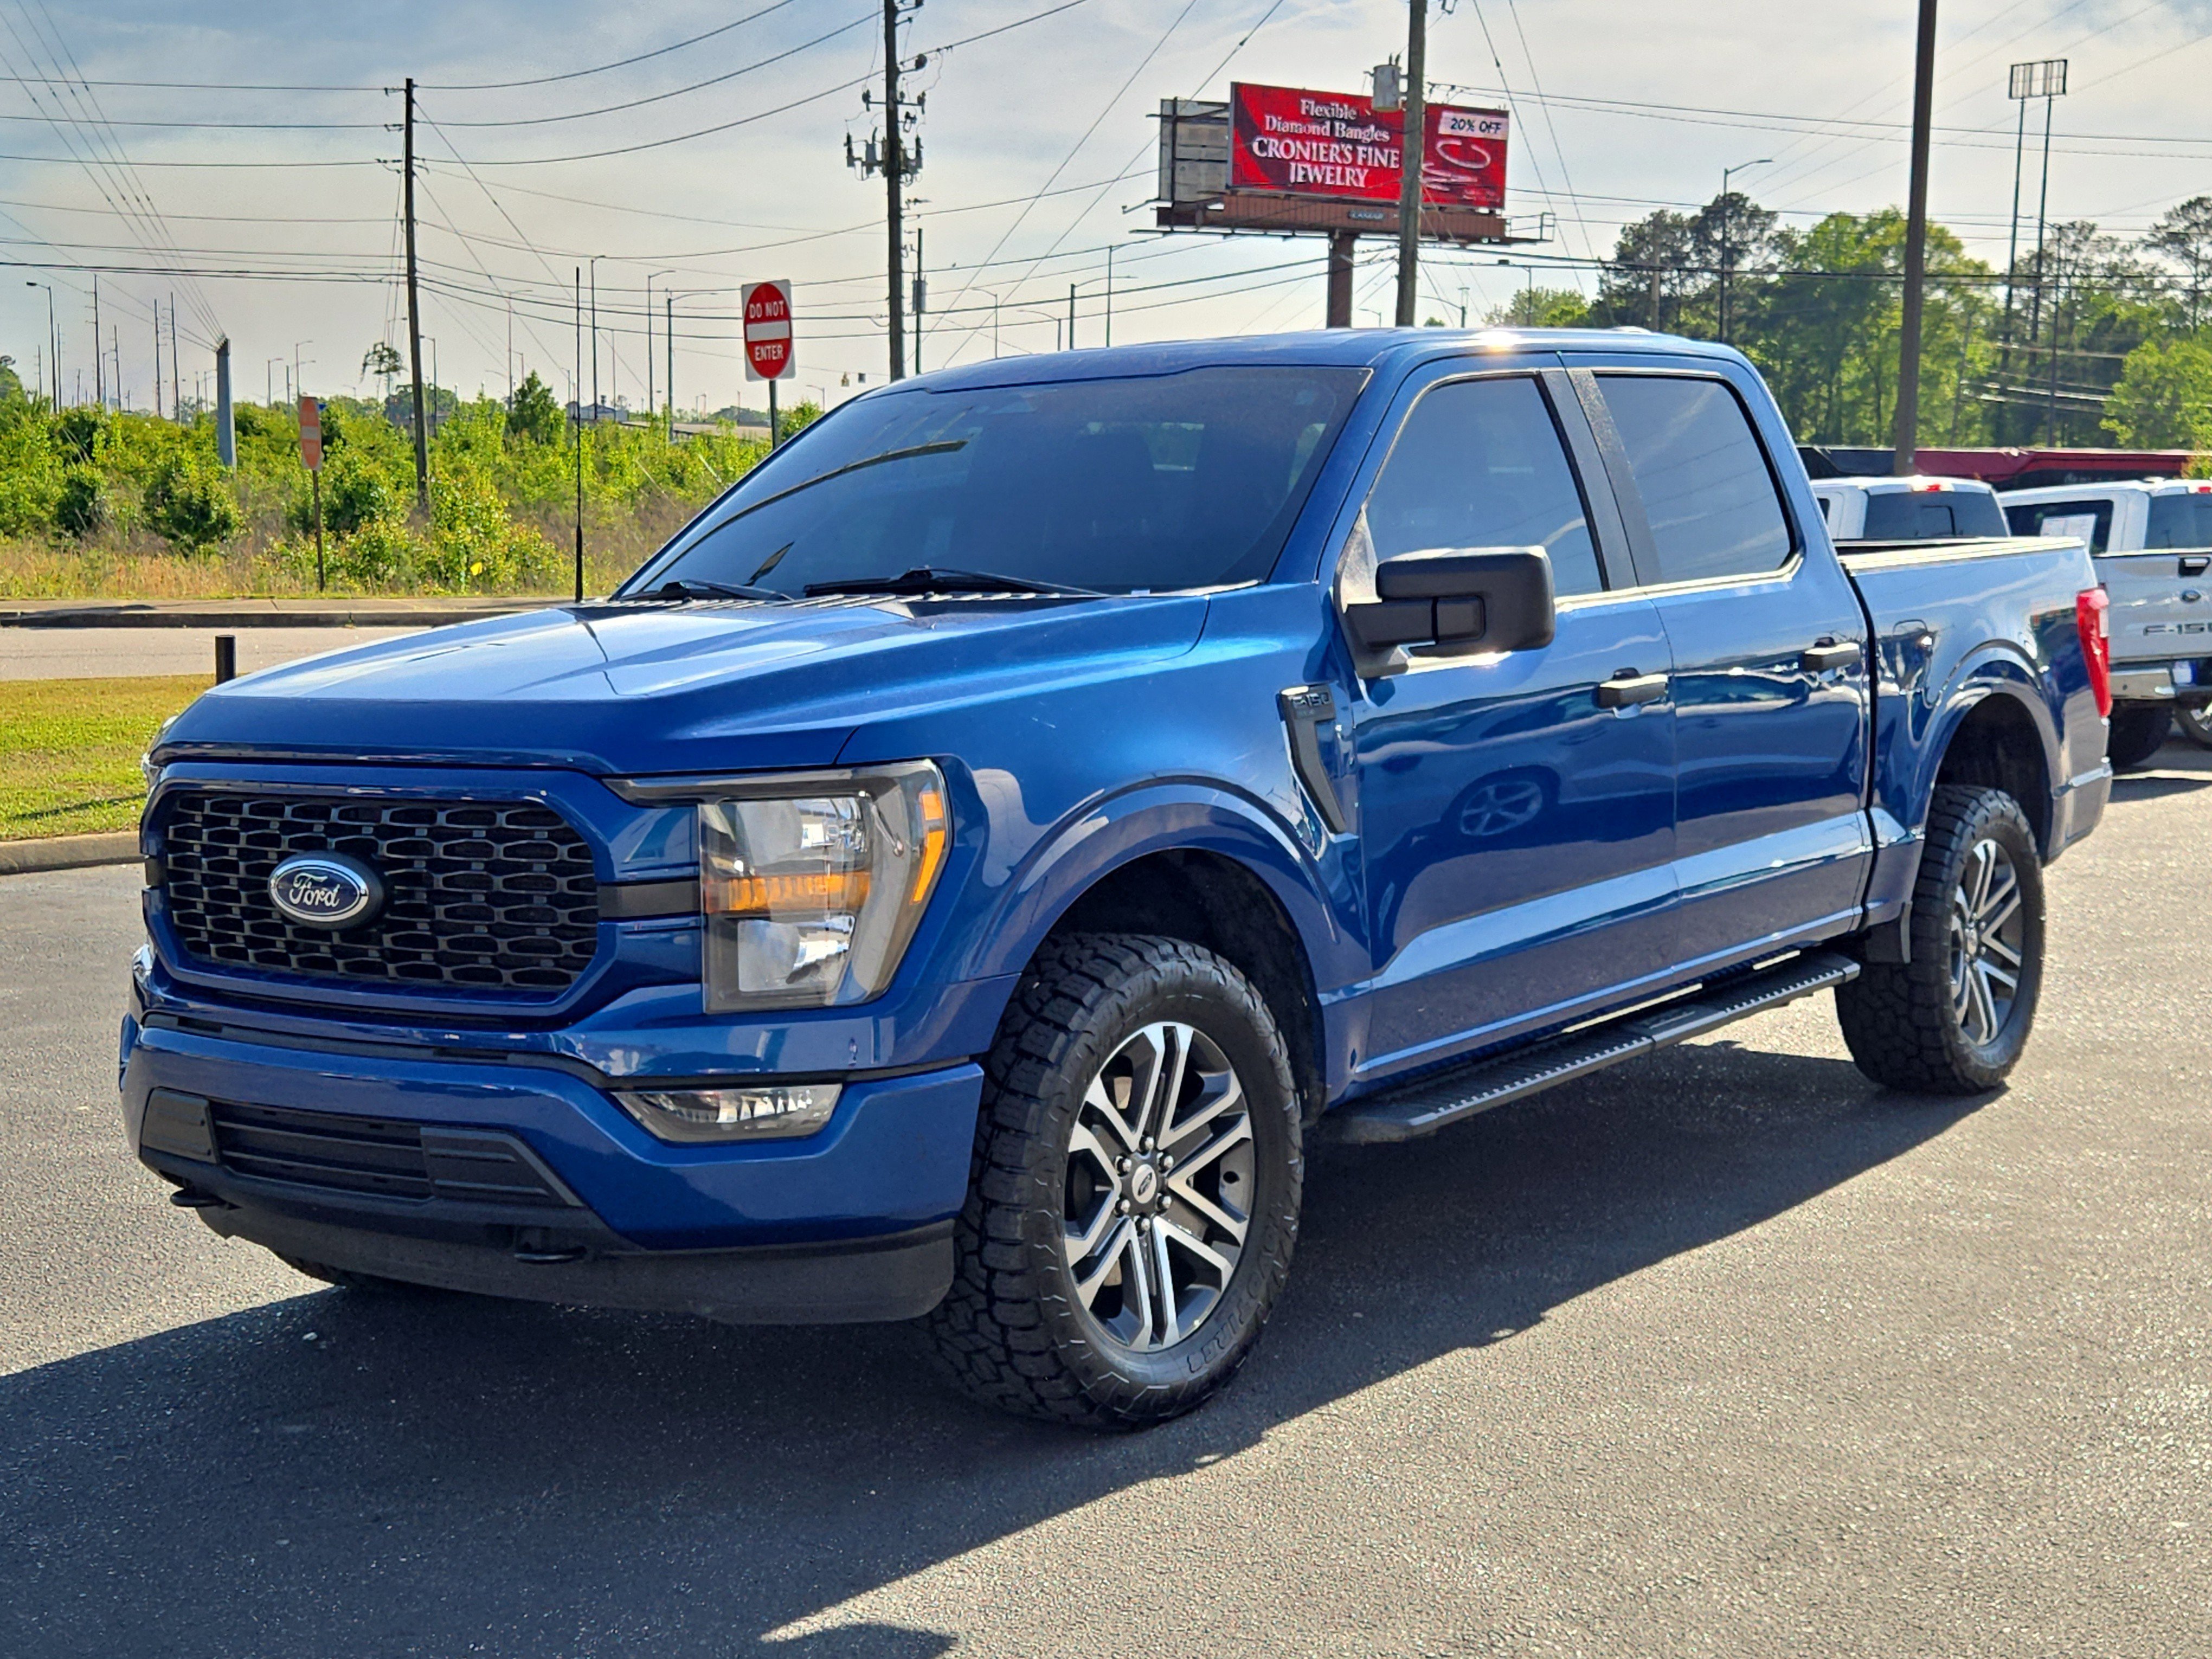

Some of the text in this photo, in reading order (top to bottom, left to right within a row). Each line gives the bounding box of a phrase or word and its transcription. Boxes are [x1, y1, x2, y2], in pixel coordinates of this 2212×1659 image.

[1301, 99, 1356, 120] Flexible
[1264, 114, 1390, 143] Diamond Bangles
[1450, 118, 1501, 134] 20% OFF
[1252, 136, 1400, 169] CRONIER'S FINE
[1289, 162, 1368, 187] JEWELRY
[749, 301, 784, 319] DO NOT
[755, 344, 784, 362] ENTER
[2143, 622, 2212, 636] F-15
[289, 872, 340, 908] Ford
